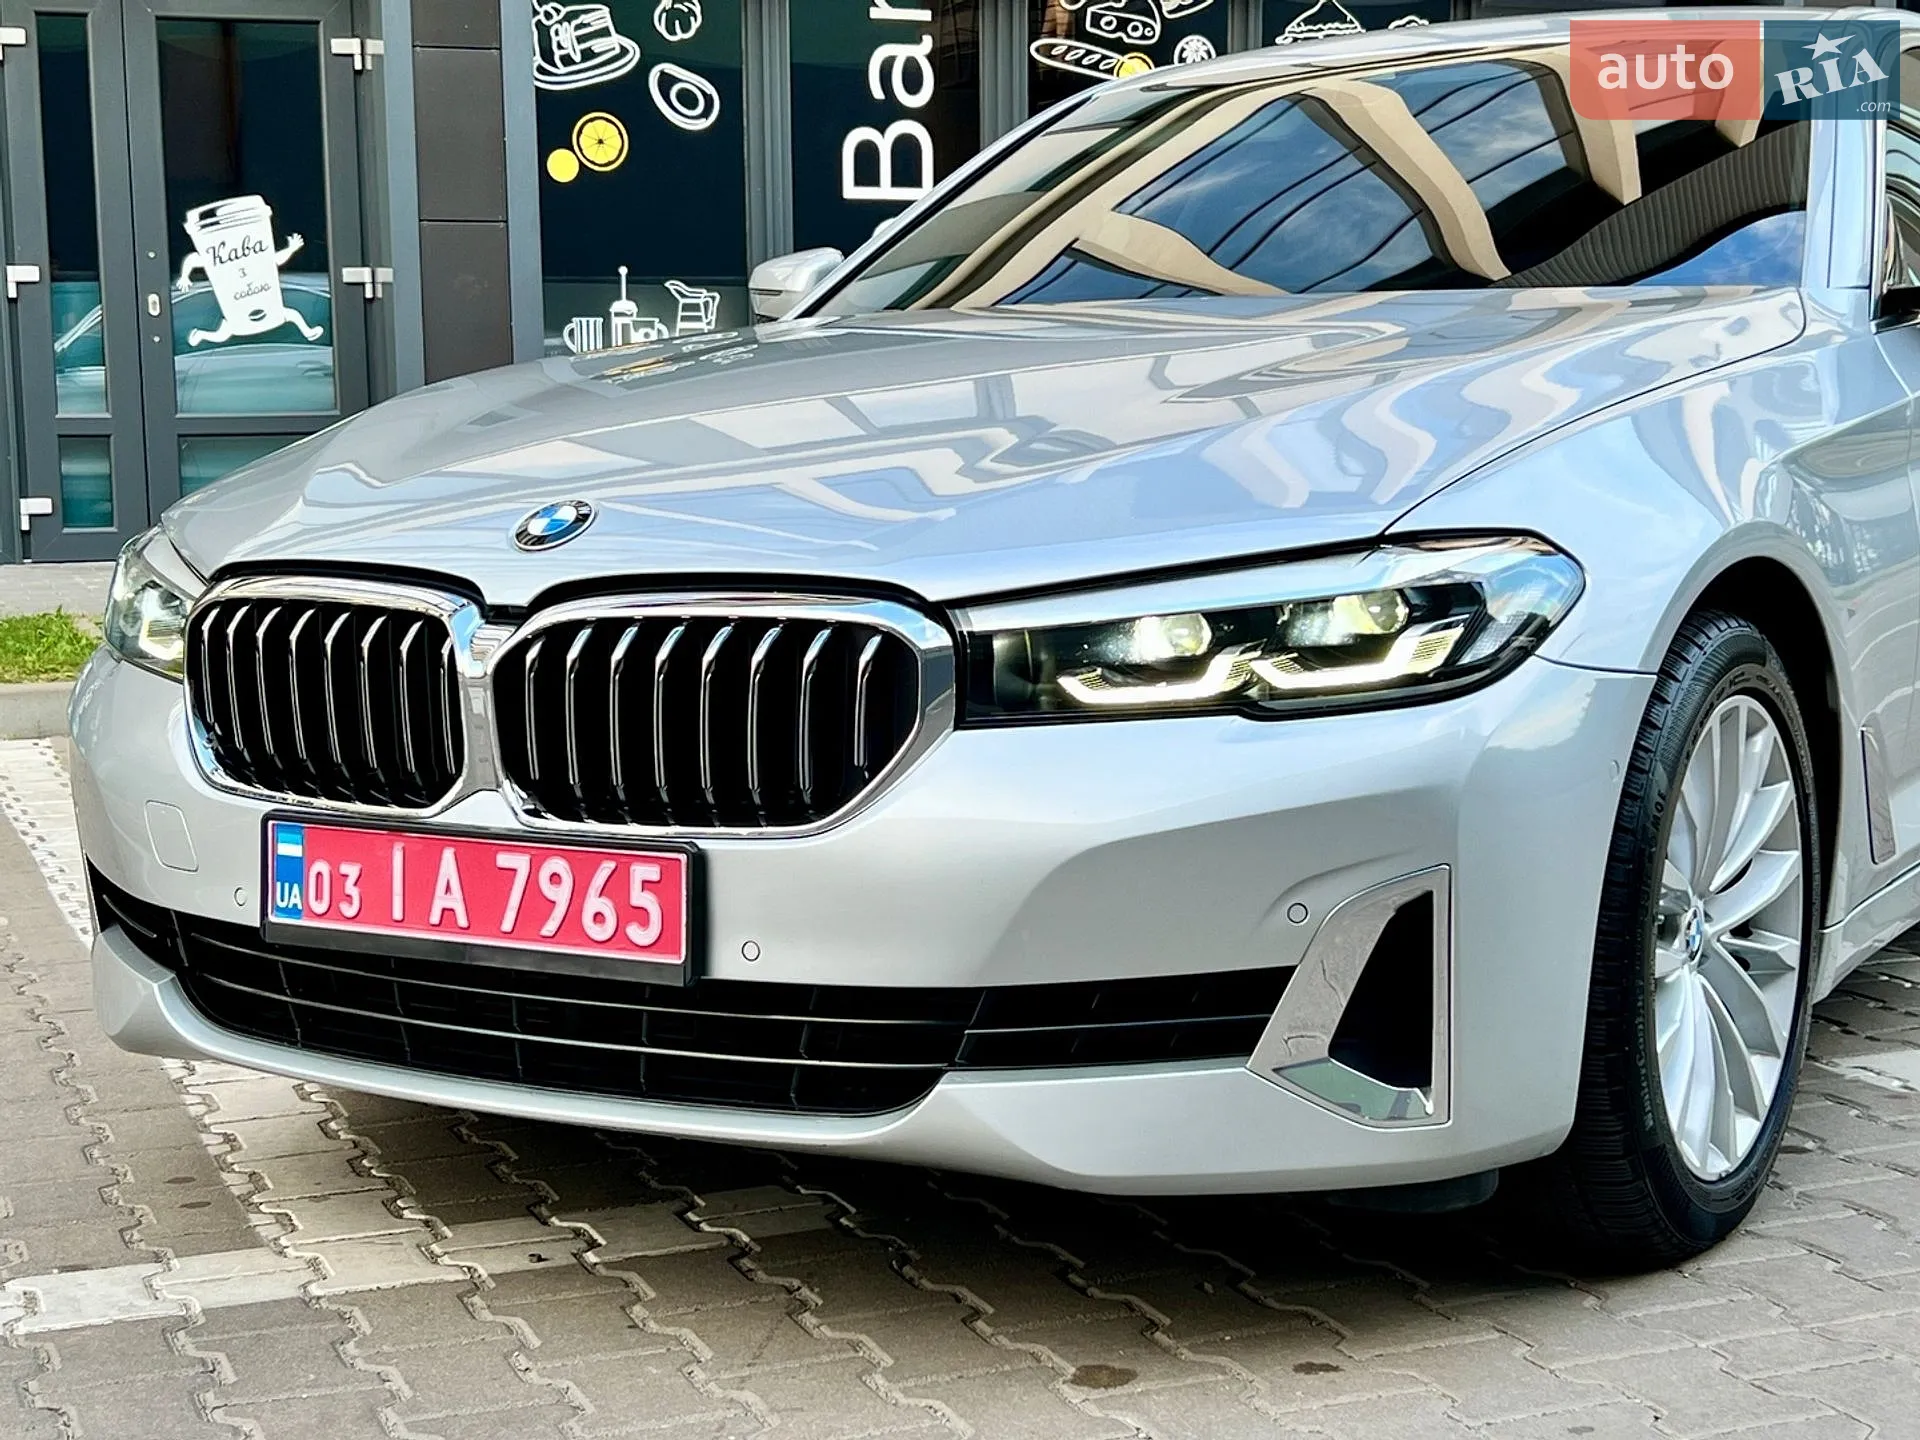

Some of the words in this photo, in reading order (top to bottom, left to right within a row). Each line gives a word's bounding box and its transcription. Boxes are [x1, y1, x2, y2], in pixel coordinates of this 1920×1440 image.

[842, 0, 934, 200] Bar
[206, 235, 269, 266] Кава
[234, 281, 271, 301] собою
[276, 881, 302, 909] UA
[308, 859, 362, 919] 03
[496, 852, 663, 947] 7965
